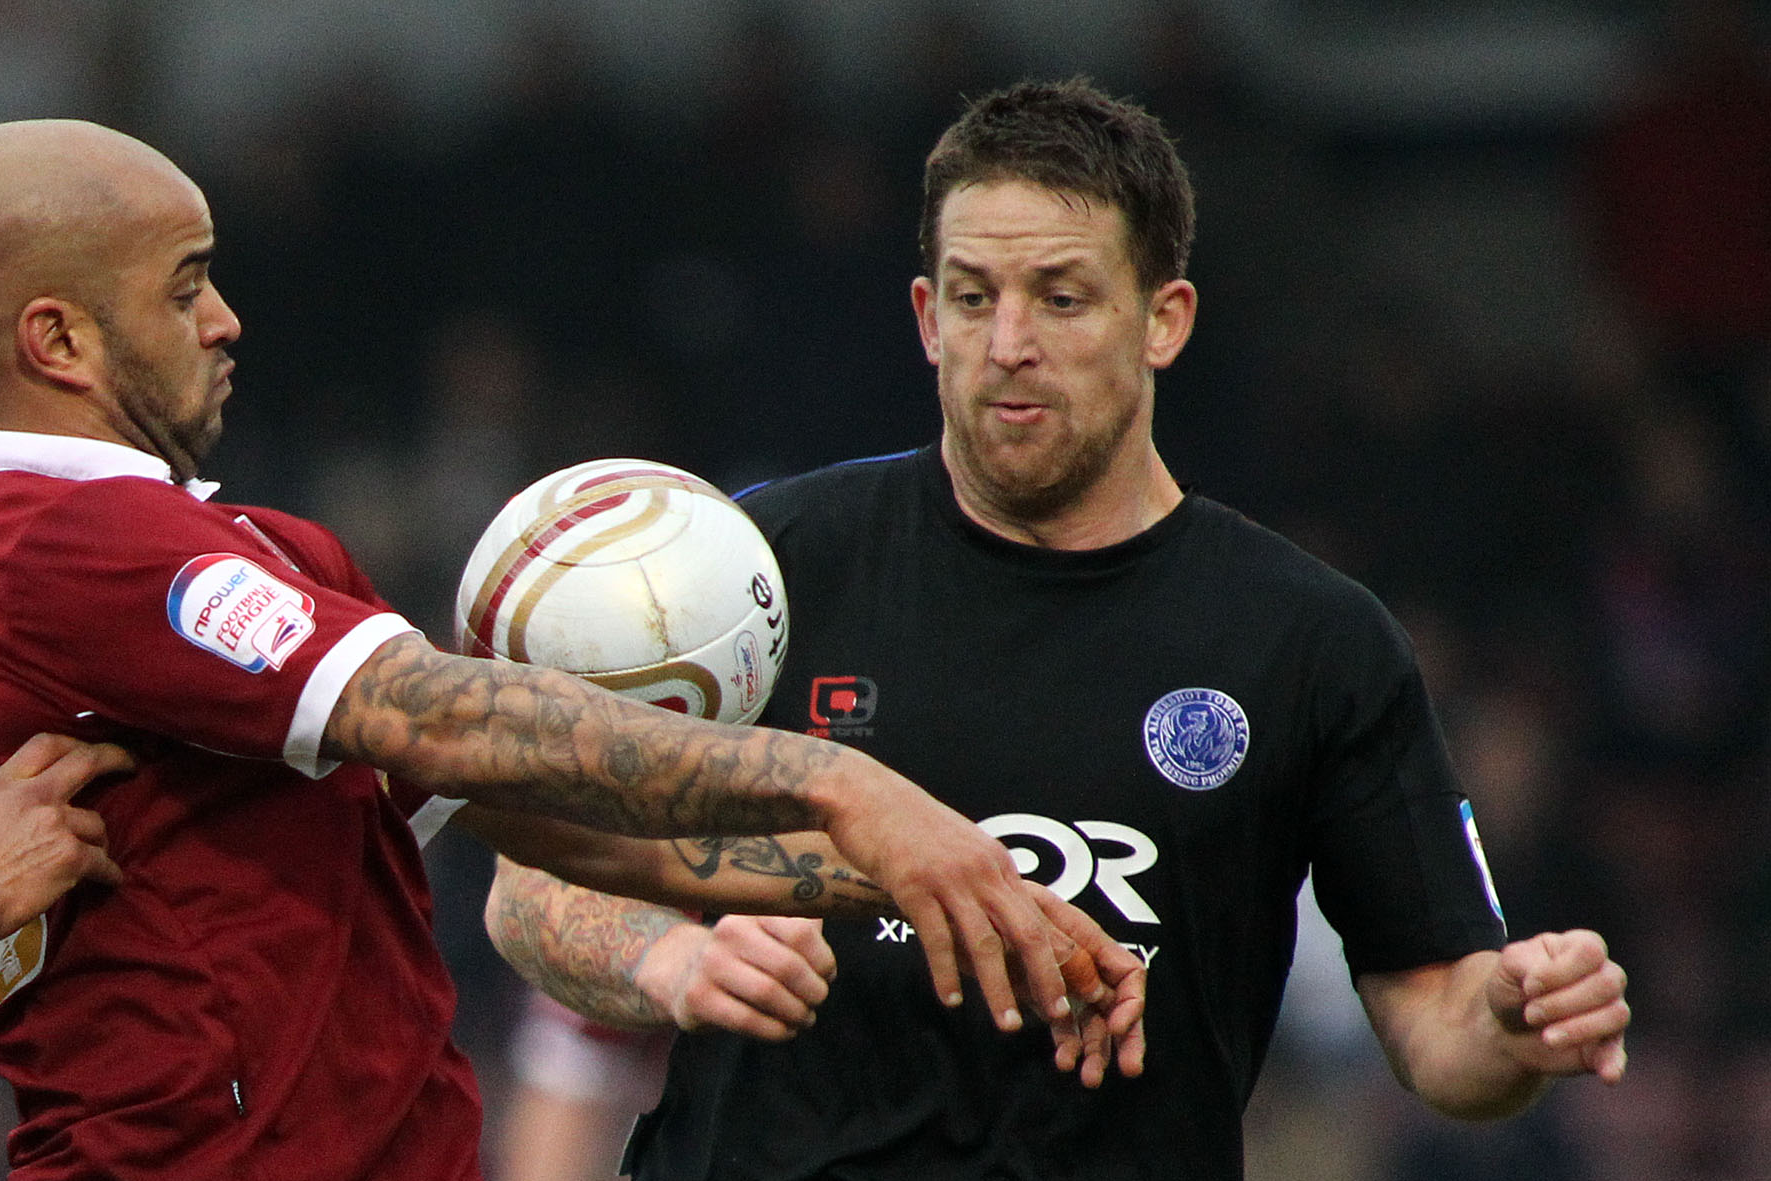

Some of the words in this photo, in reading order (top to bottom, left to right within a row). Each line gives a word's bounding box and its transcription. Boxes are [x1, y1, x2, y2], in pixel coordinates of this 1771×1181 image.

[194, 566, 251, 637] npower
[216, 584, 272, 643] FOOTBALL
[224, 589, 282, 652] LEAGUE
[1207, 692, 1246, 720] TOWN
[1161, 761, 1199, 785] RISING
[1200, 750, 1245, 786] PHOENIX
